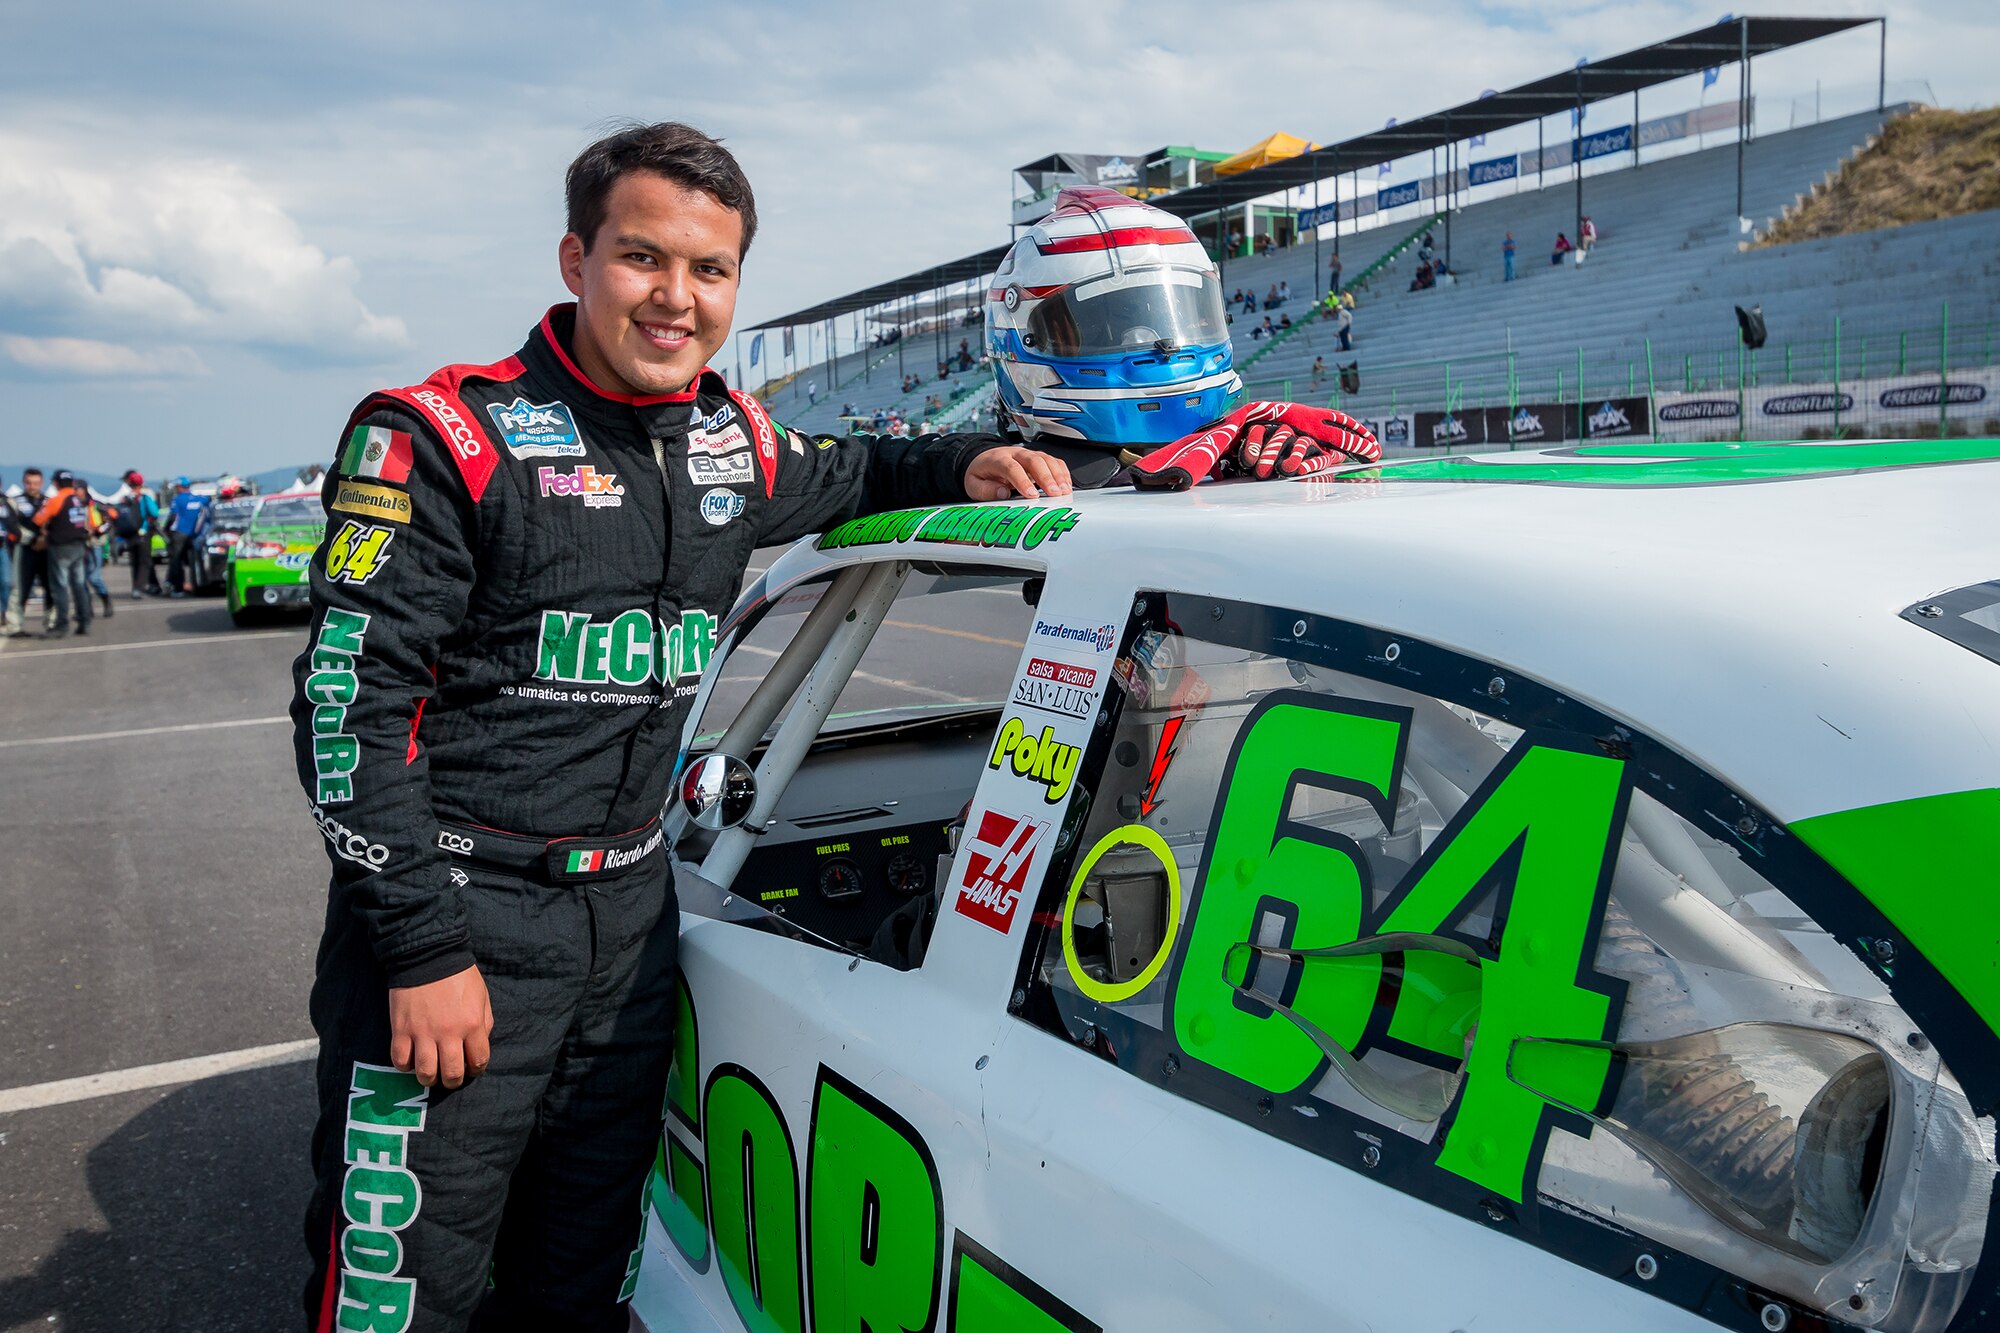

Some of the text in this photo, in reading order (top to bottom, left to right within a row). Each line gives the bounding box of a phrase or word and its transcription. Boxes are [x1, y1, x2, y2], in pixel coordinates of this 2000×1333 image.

[1097, 164, 1138, 180] PEAK
[1883, 386, 1982, 406] FREIGHTINER
[500, 409, 564, 430] PEAK
[1588, 408, 1630, 432] PEAK
[1662, 404, 1737, 419] FREIGHTLINER
[411, 390, 480, 459] sparco
[526, 426, 556, 434] NASCAR
[1432, 420, 1467, 439] PEAK
[1507, 415, 1544, 435] PEAK
[515, 434, 540, 443] MEXICO
[558, 446, 581, 454] telcel
[538, 466, 617, 496] FedEx
[698, 470, 751, 482] smartphones
[339, 488, 397, 510] Continental
[584, 495, 620, 508] Express
[709, 496, 731, 510] FOX
[818, 508, 940, 549] RICARDO
[914, 505, 1038, 549] ABARCA
[326, 520, 395, 585] 64
[1035, 621, 1098, 643] Parafernalia
[1030, 661, 1054, 678] salsa
[1058, 666, 1094, 686] picante
[572, 690, 587, 702] de
[989, 717, 1081, 805] Poky
[816, 843, 850, 855] FUEL PRES
[881, 835, 910, 847] OIL PRES
[604, 844, 642, 869] Ricardo
[761, 888, 799, 901] BRAKE FAN
[961, 877, 1022, 916] HAAS
[1166, 690, 1632, 1208] 64
